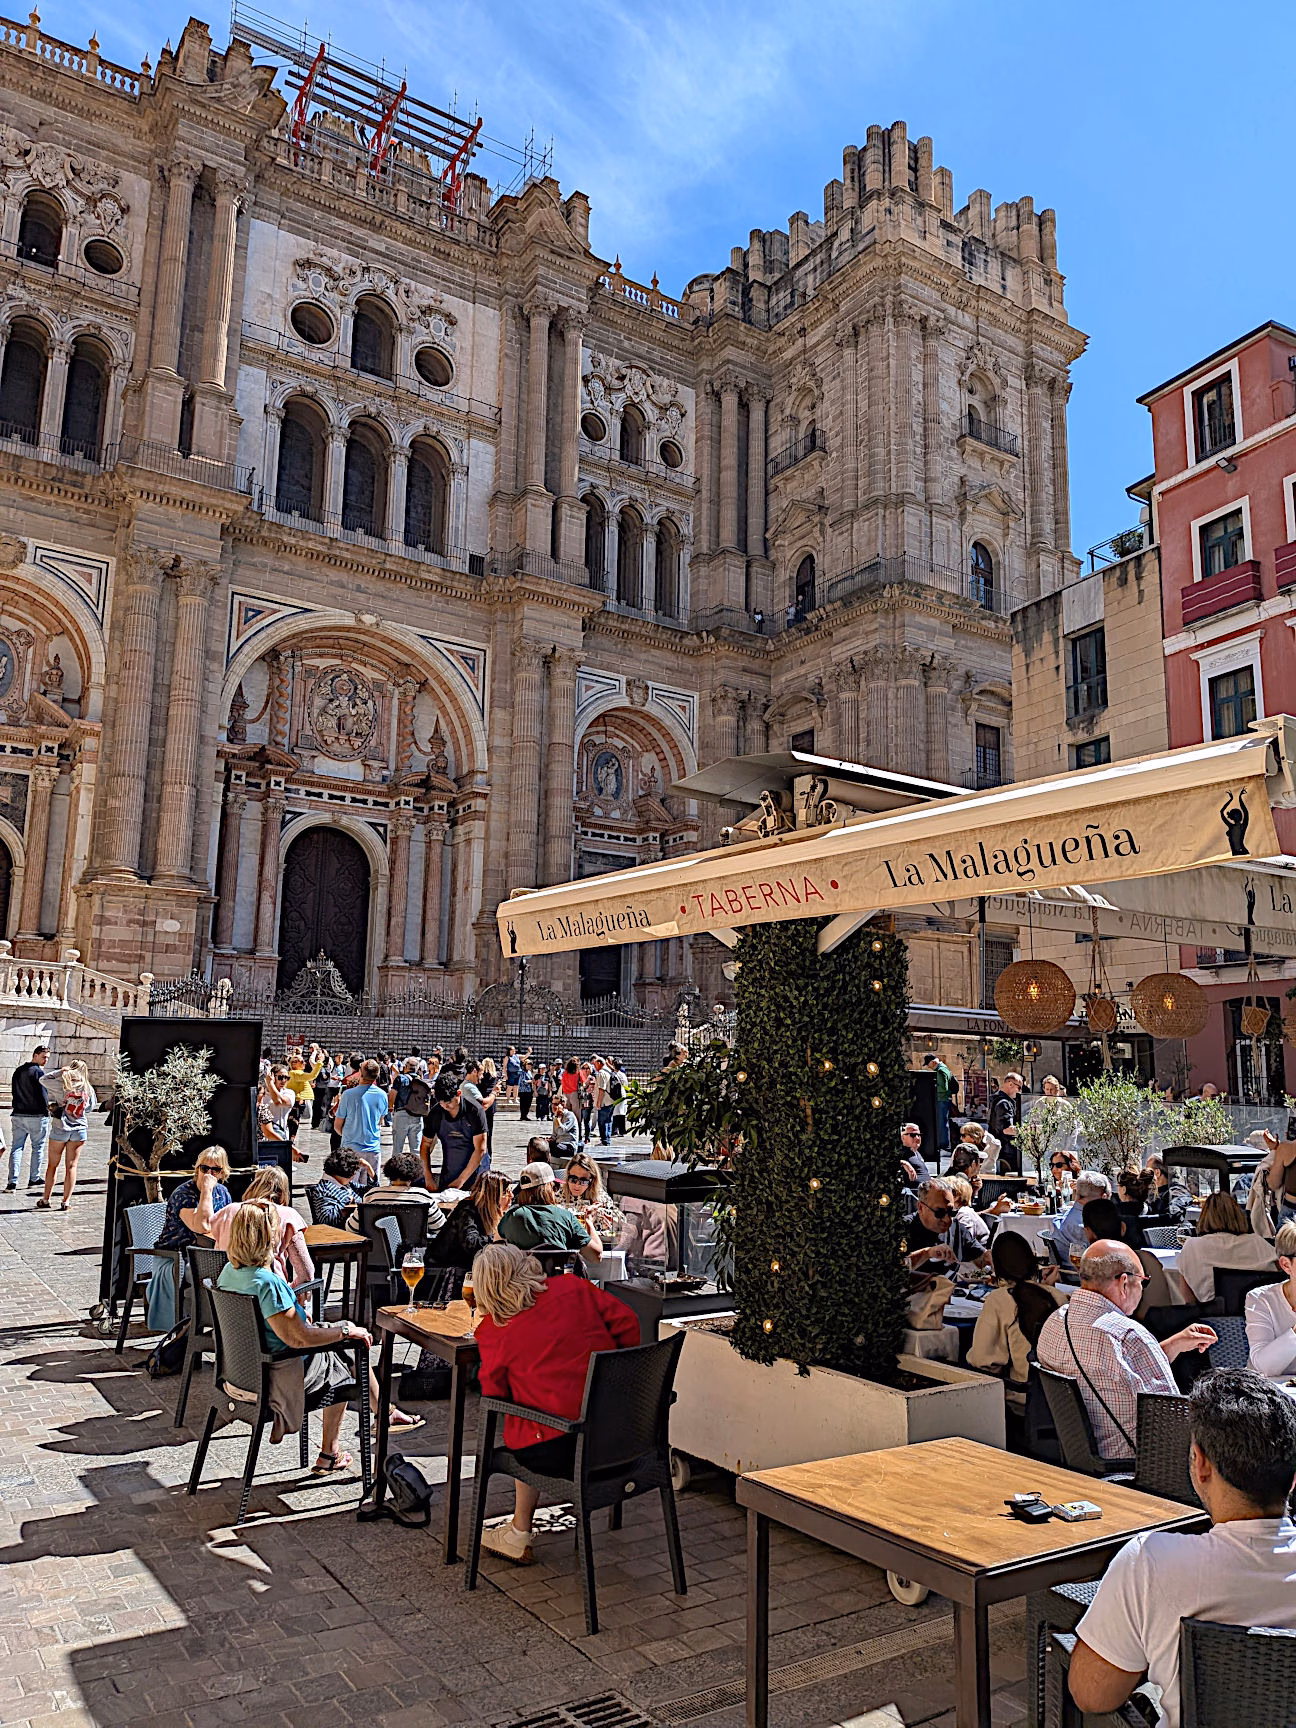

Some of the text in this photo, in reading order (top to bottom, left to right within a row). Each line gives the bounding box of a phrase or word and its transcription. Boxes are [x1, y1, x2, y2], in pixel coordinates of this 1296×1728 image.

[882, 823, 1142, 889] La Malagueña
[691, 875, 825, 919] TABERNA
[1269, 885, 1294, 914] La
[536, 905, 652, 941] La Malagueña
[966, 1018, 980, 1031] LA
